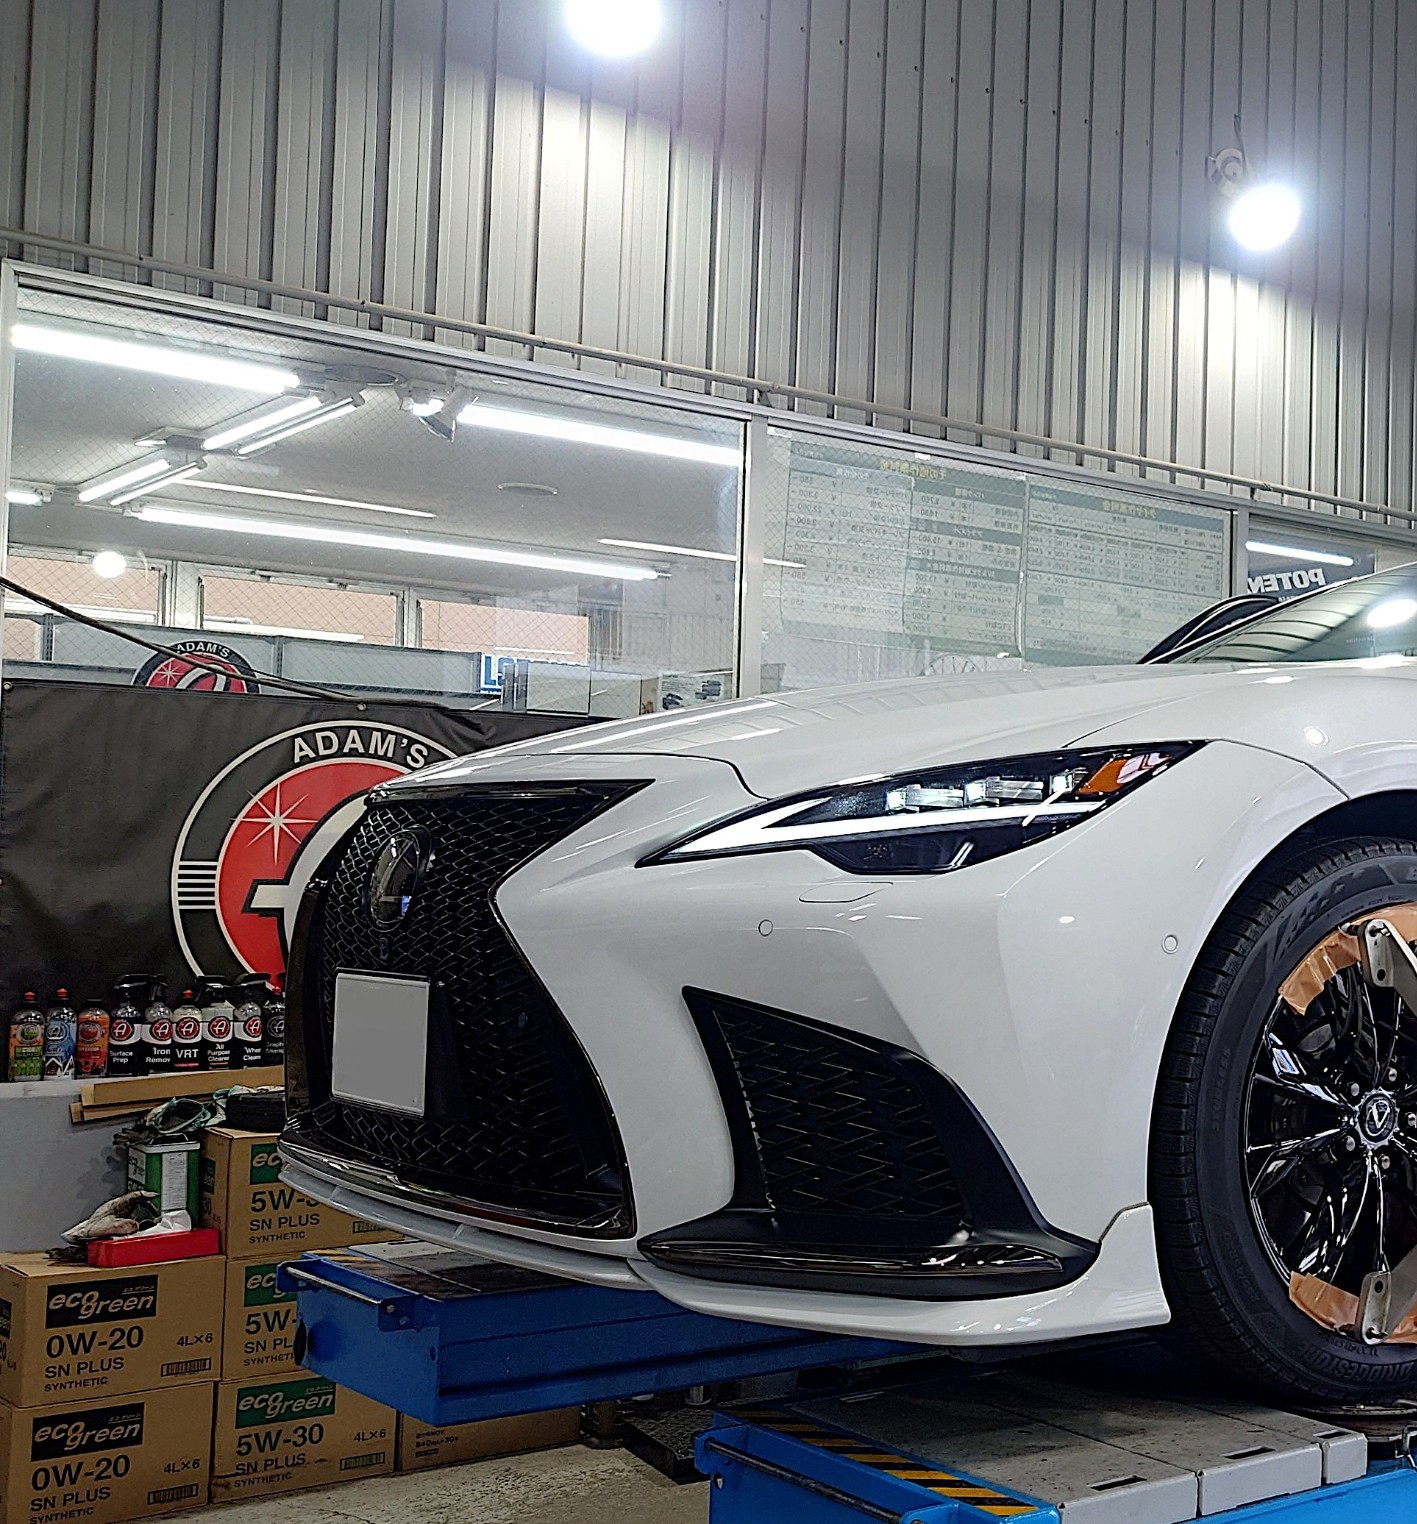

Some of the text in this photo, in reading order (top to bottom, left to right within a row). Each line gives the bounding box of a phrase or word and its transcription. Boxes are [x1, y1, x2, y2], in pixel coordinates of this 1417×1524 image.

[175, 1048, 199, 1058] VRT
[249, 1213, 321, 1232] SN PLUS
[248, 1230, 306, 1245] SYNTHETIC
[45, 1325, 145, 1360] 0W-20
[243, 1336, 293, 1354] SN PL
[44, 1356, 125, 1380] SN PLUS
[243, 1352, 295, 1367] SYNTHETI
[44, 1376, 109, 1392] SYNTHETIC
[235, 1422, 324, 1457] 5W-30
[31, 1454, 131, 1492] 0W-20
[235, 1452, 307, 1476] SN PLUS
[233, 1472, 292, 1488] SYNTHETIC
[30, 1486, 111, 1513] SN PLUS
[29, 1506, 94, 1524] SYNTHETIC
